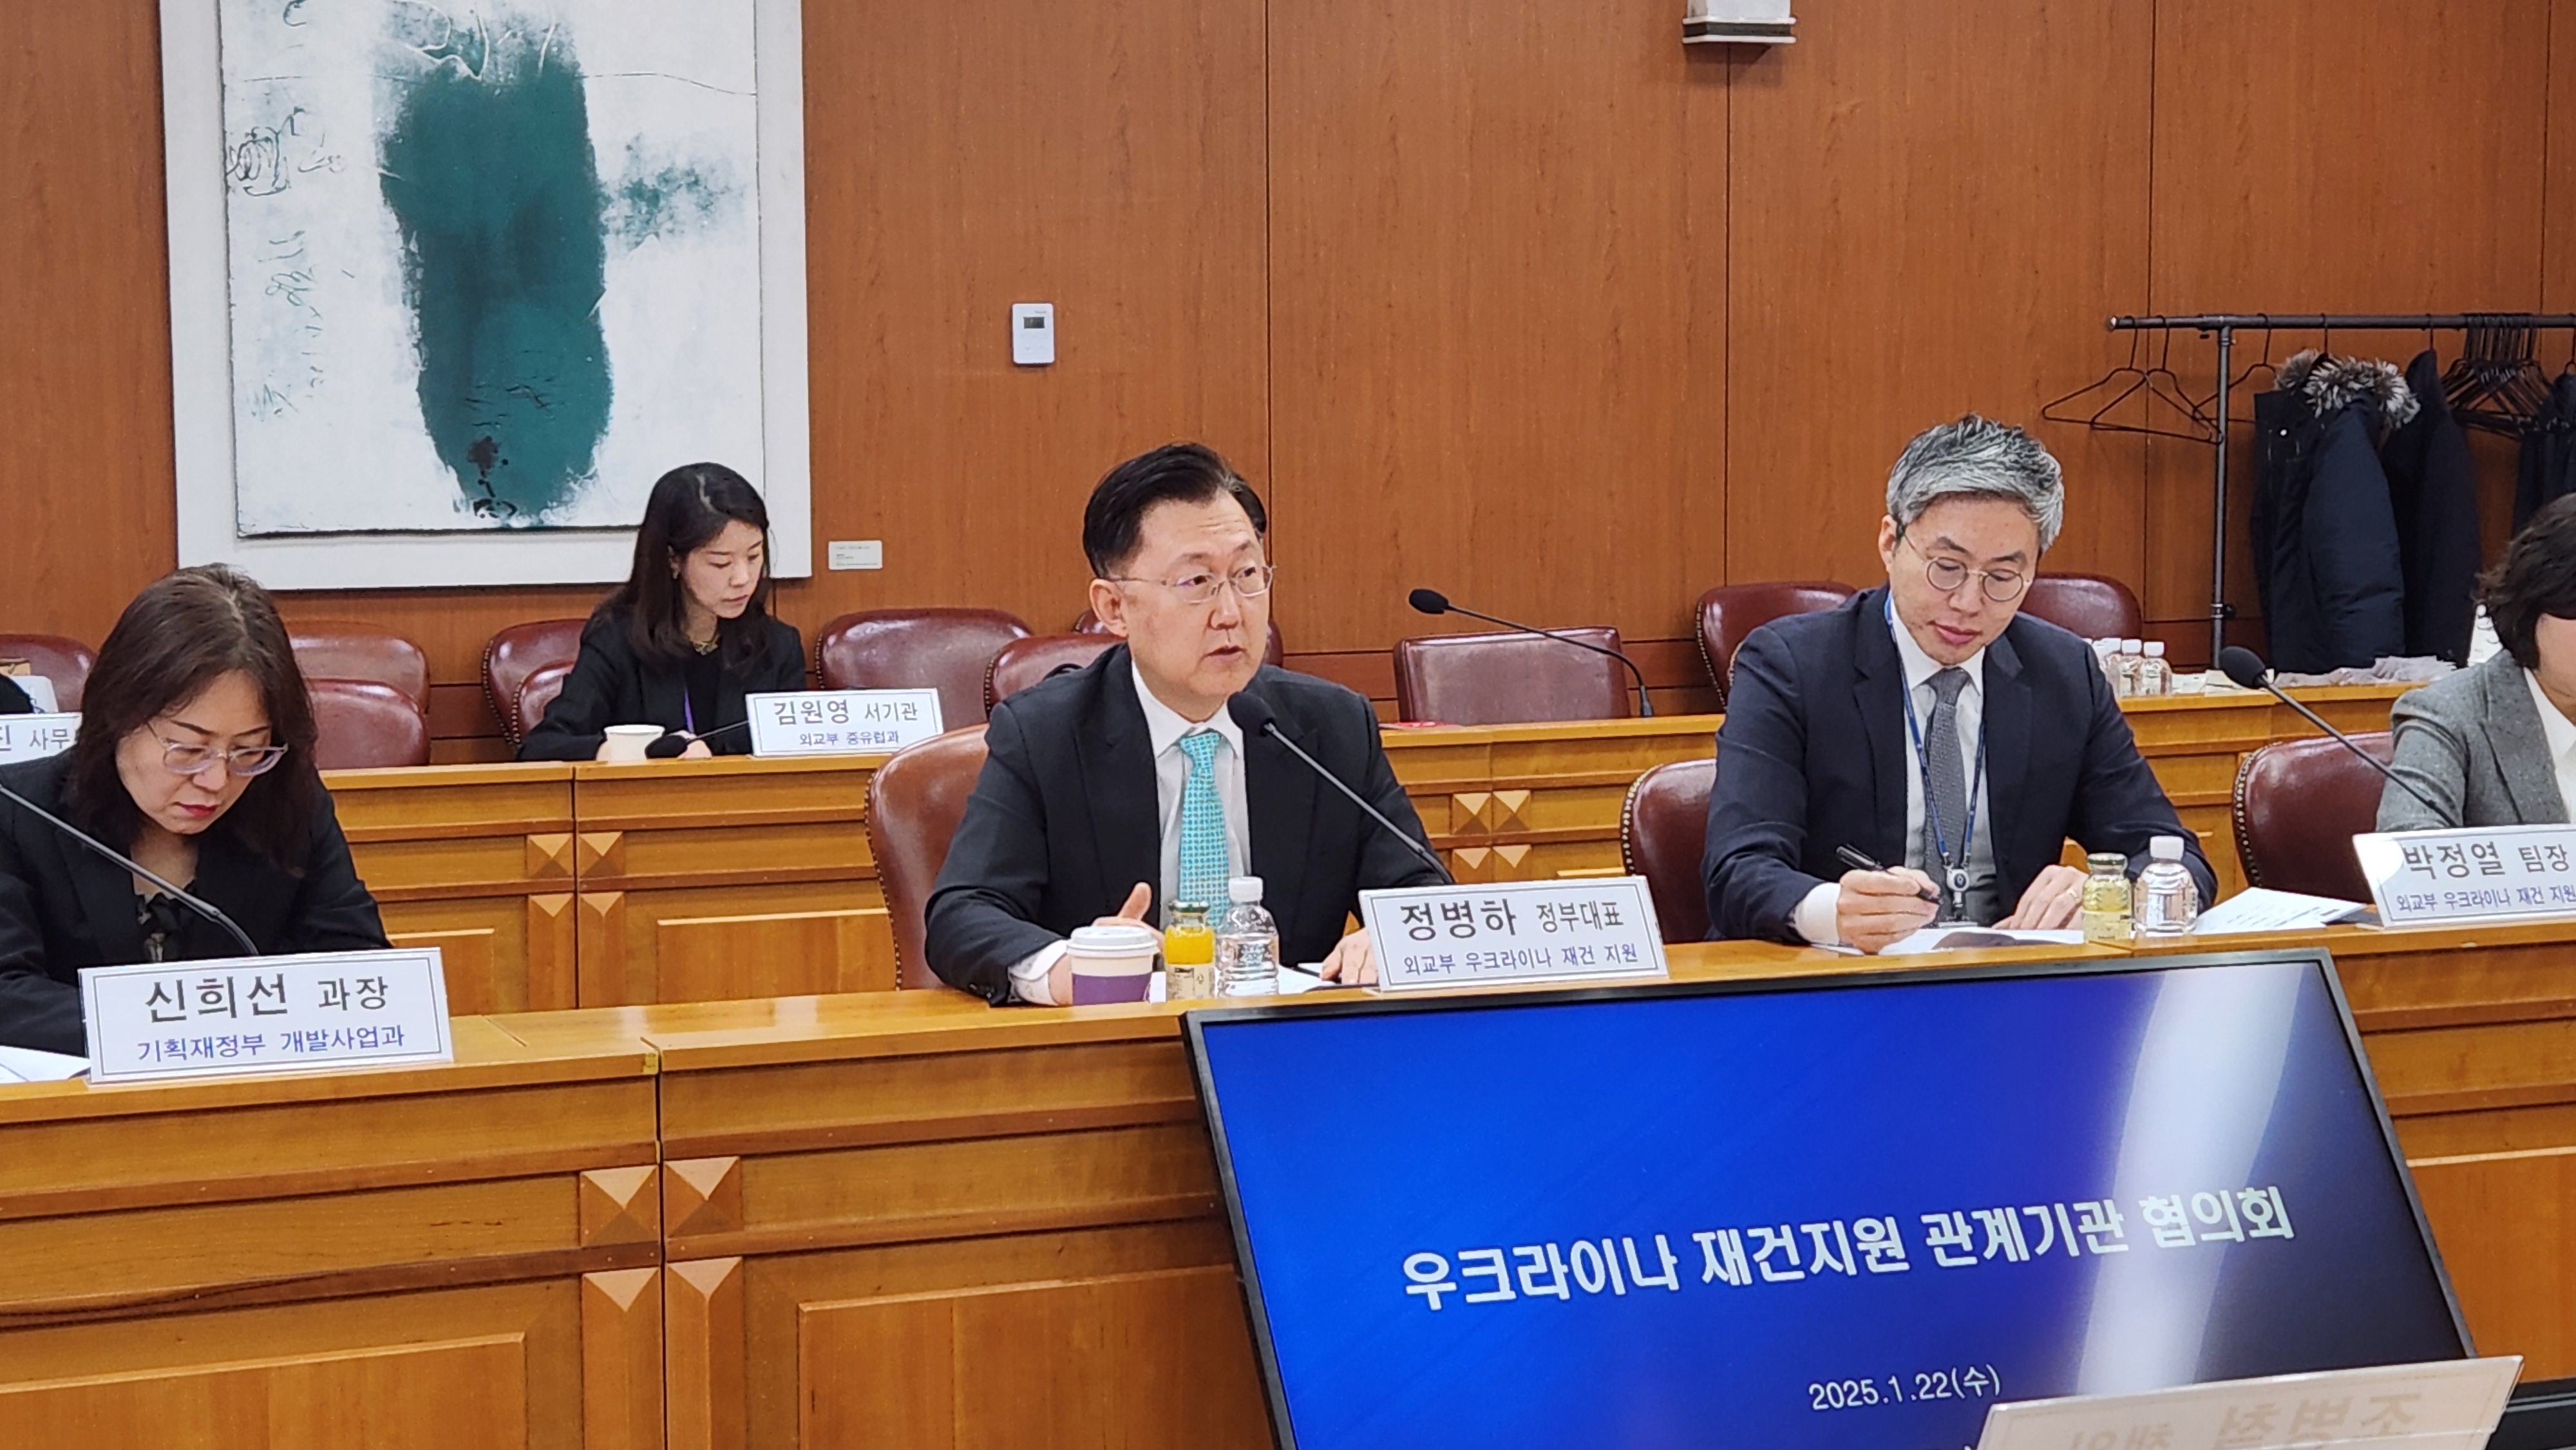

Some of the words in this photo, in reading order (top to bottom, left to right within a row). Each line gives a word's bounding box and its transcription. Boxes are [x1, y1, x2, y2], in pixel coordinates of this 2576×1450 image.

[773, 699, 849, 726] 김원영
[865, 702, 918, 722] 서기관
[29, 728, 77, 750] 사무
[799, 733, 839, 746] 외교부
[2402, 841, 2506, 880] 박정열
[2518, 844, 2570, 872] 팀장
[2396, 893, 2438, 912] 외교부
[2443, 888, 2512, 910] 우크라이나
[2516, 885, 2545, 905] 재건
[2549, 884, 2576, 903] 지원
[1400, 898, 1517, 941] 정병하
[1536, 900, 1625, 932] 정부대표
[1403, 954, 1456, 975] 외교부
[1466, 947, 1552, 972] 우크라이나
[1562, 945, 1596, 966] 재건
[1604, 943, 1639, 964] 지원
[145, 973, 288, 1022] 신희선
[317, 976, 388, 1011] 과장
[137, 1034, 266, 1062] 기획재정부
[281, 1024, 405, 1054] 개발사업과
[1403, 1234, 1679, 1311] 우크라이나
[1692, 1216, 1910, 1286] 재건지원
[1920, 1199, 2128, 1268] 관계기관
[2139, 1186, 2295, 1248] 협의회
[1809, 1363, 2000, 1410] 2025.1.22(수)
